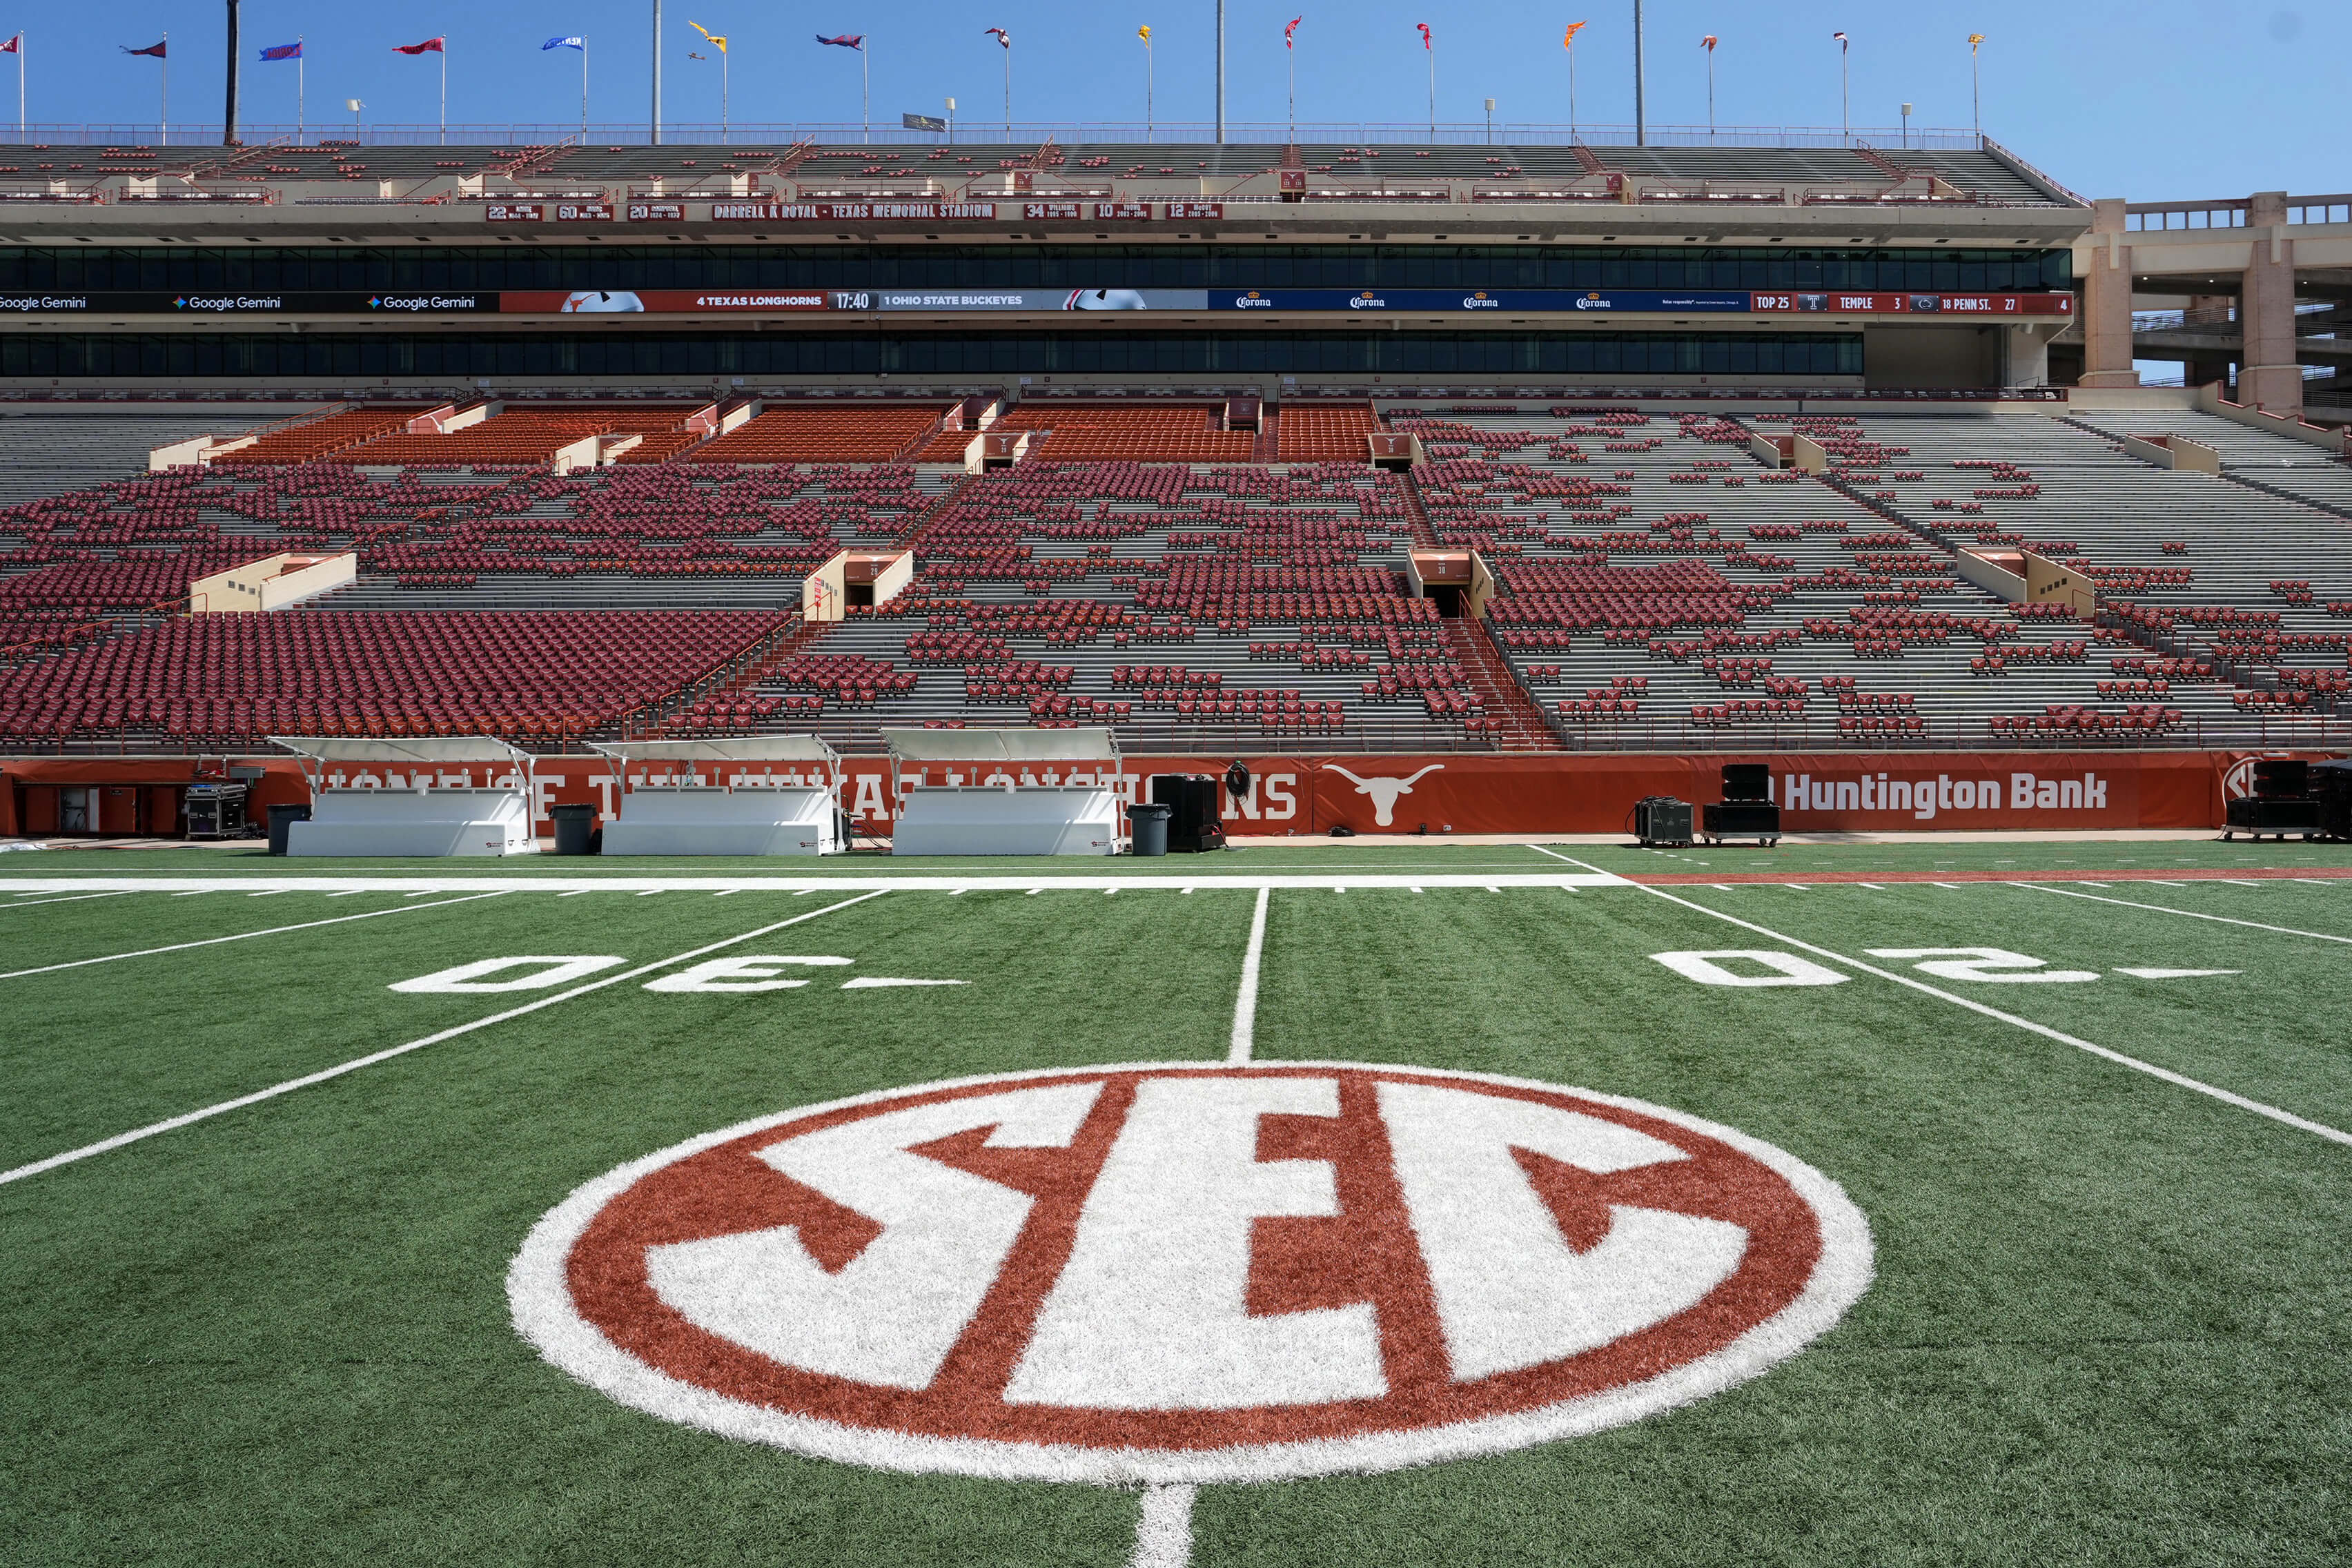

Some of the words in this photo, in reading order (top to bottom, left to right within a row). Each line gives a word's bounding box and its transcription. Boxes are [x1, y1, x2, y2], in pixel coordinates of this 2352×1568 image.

[489, 206, 507, 219] 22
[559, 206, 578, 219] 60
[630, 206, 648, 219] 20
[714, 206, 765, 218] DARRELL
[770, 206, 778, 218] K
[782, 206, 818, 218] ROYAL
[832, 205, 868, 217] TEXAS
[873, 205, 935, 217] MEMORIAL
[939, 204, 992, 217] STADIUM
[1028, 204, 1044, 217] 34
[1099, 204, 1113, 217] 10
[1170, 204, 1184, 217] 12
[41, 297, 86, 308] Gemini
[189, 297, 234, 311] Google
[237, 297, 280, 308] Gemini
[384, 297, 429, 311] Google
[431, 297, 474, 308] Gemini
[697, 297, 705, 306] 4
[707, 297, 747, 306] TEXAS
[749, 297, 821, 306] LONGHORNS
[836, 293, 869, 308] 17:40
[1236, 296, 1271, 308] Corona
[1350, 295, 1384, 309] Corona
[1463, 296, 1498, 309] Corona
[1576, 296, 1611, 310] Corona
[1757, 297, 1775, 308] TOP
[1778, 297, 1789, 308] 25
[1840, 297, 1872, 308] TEMPLE
[1894, 297, 1900, 309] 3
[1943, 299, 1951, 309] 18
[1954, 299, 1977, 310] PENN
[1979, 299, 1991, 310] ST.
[2005, 299, 2015, 310] 27
[2060, 300, 2067, 310] 4
[1785, 773, 2000, 819] Huntington
[2010, 772, 2107, 809] Bank
[644, 1075, 1750, 1409] SEC
